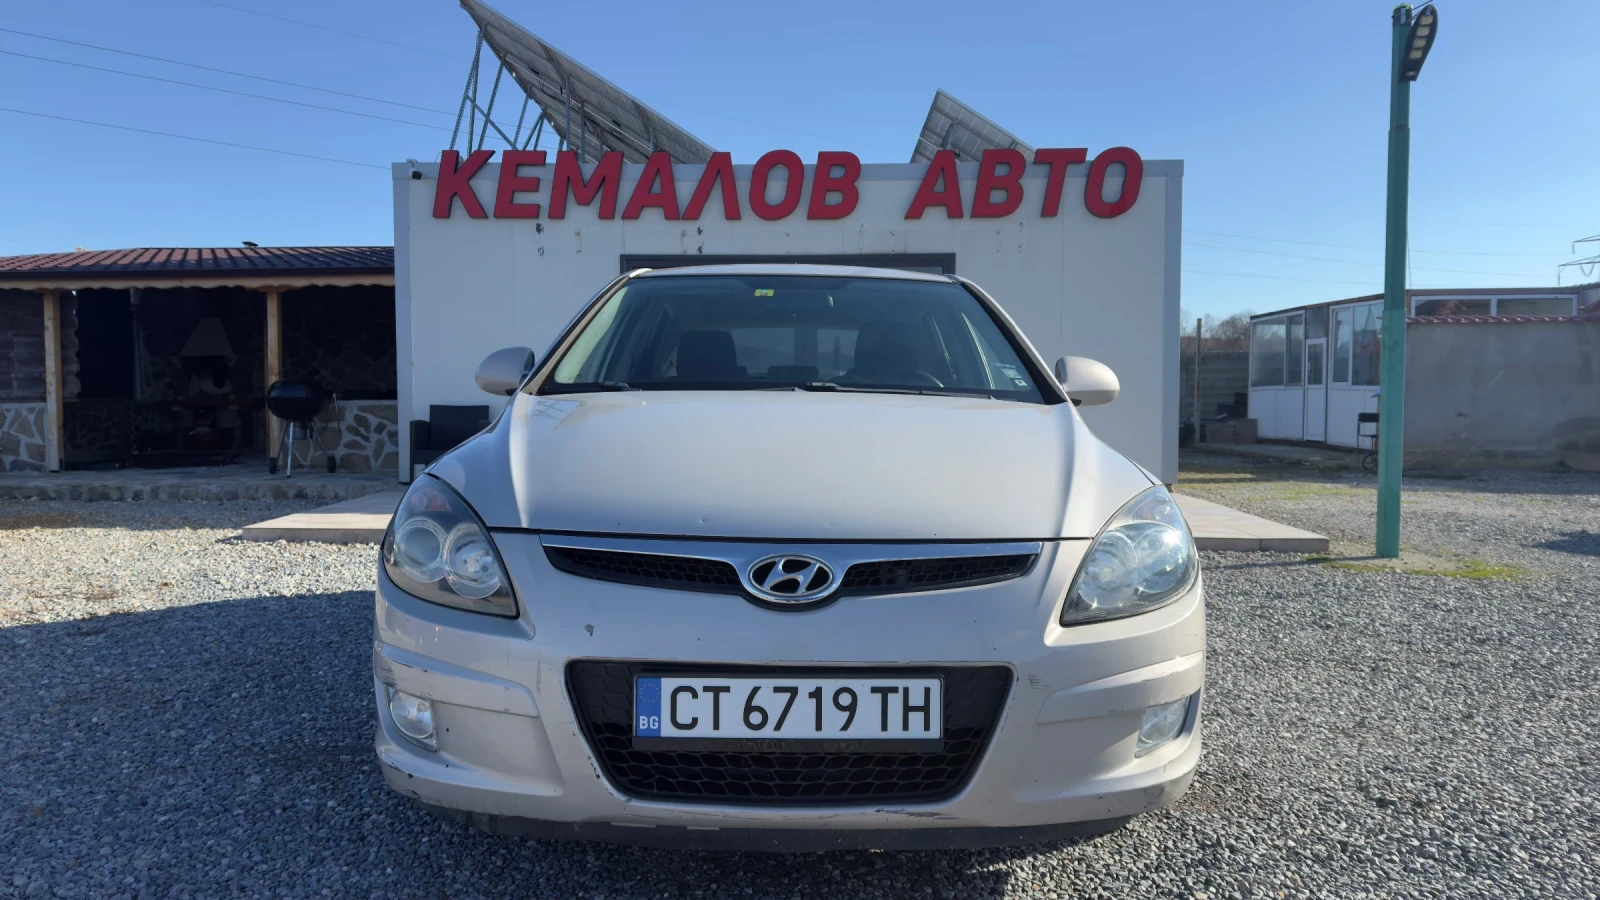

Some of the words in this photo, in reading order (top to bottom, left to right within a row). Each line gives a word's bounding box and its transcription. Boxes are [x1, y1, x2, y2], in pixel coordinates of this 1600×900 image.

[432, 150, 861, 220] КЕМАЛОВ
[904, 146, 1143, 219] АВТО
[639, 715, 659, 730] BG
[670, 685, 731, 731] CT
[742, 686, 858, 732] 6719
[870, 686, 931, 732] TH
